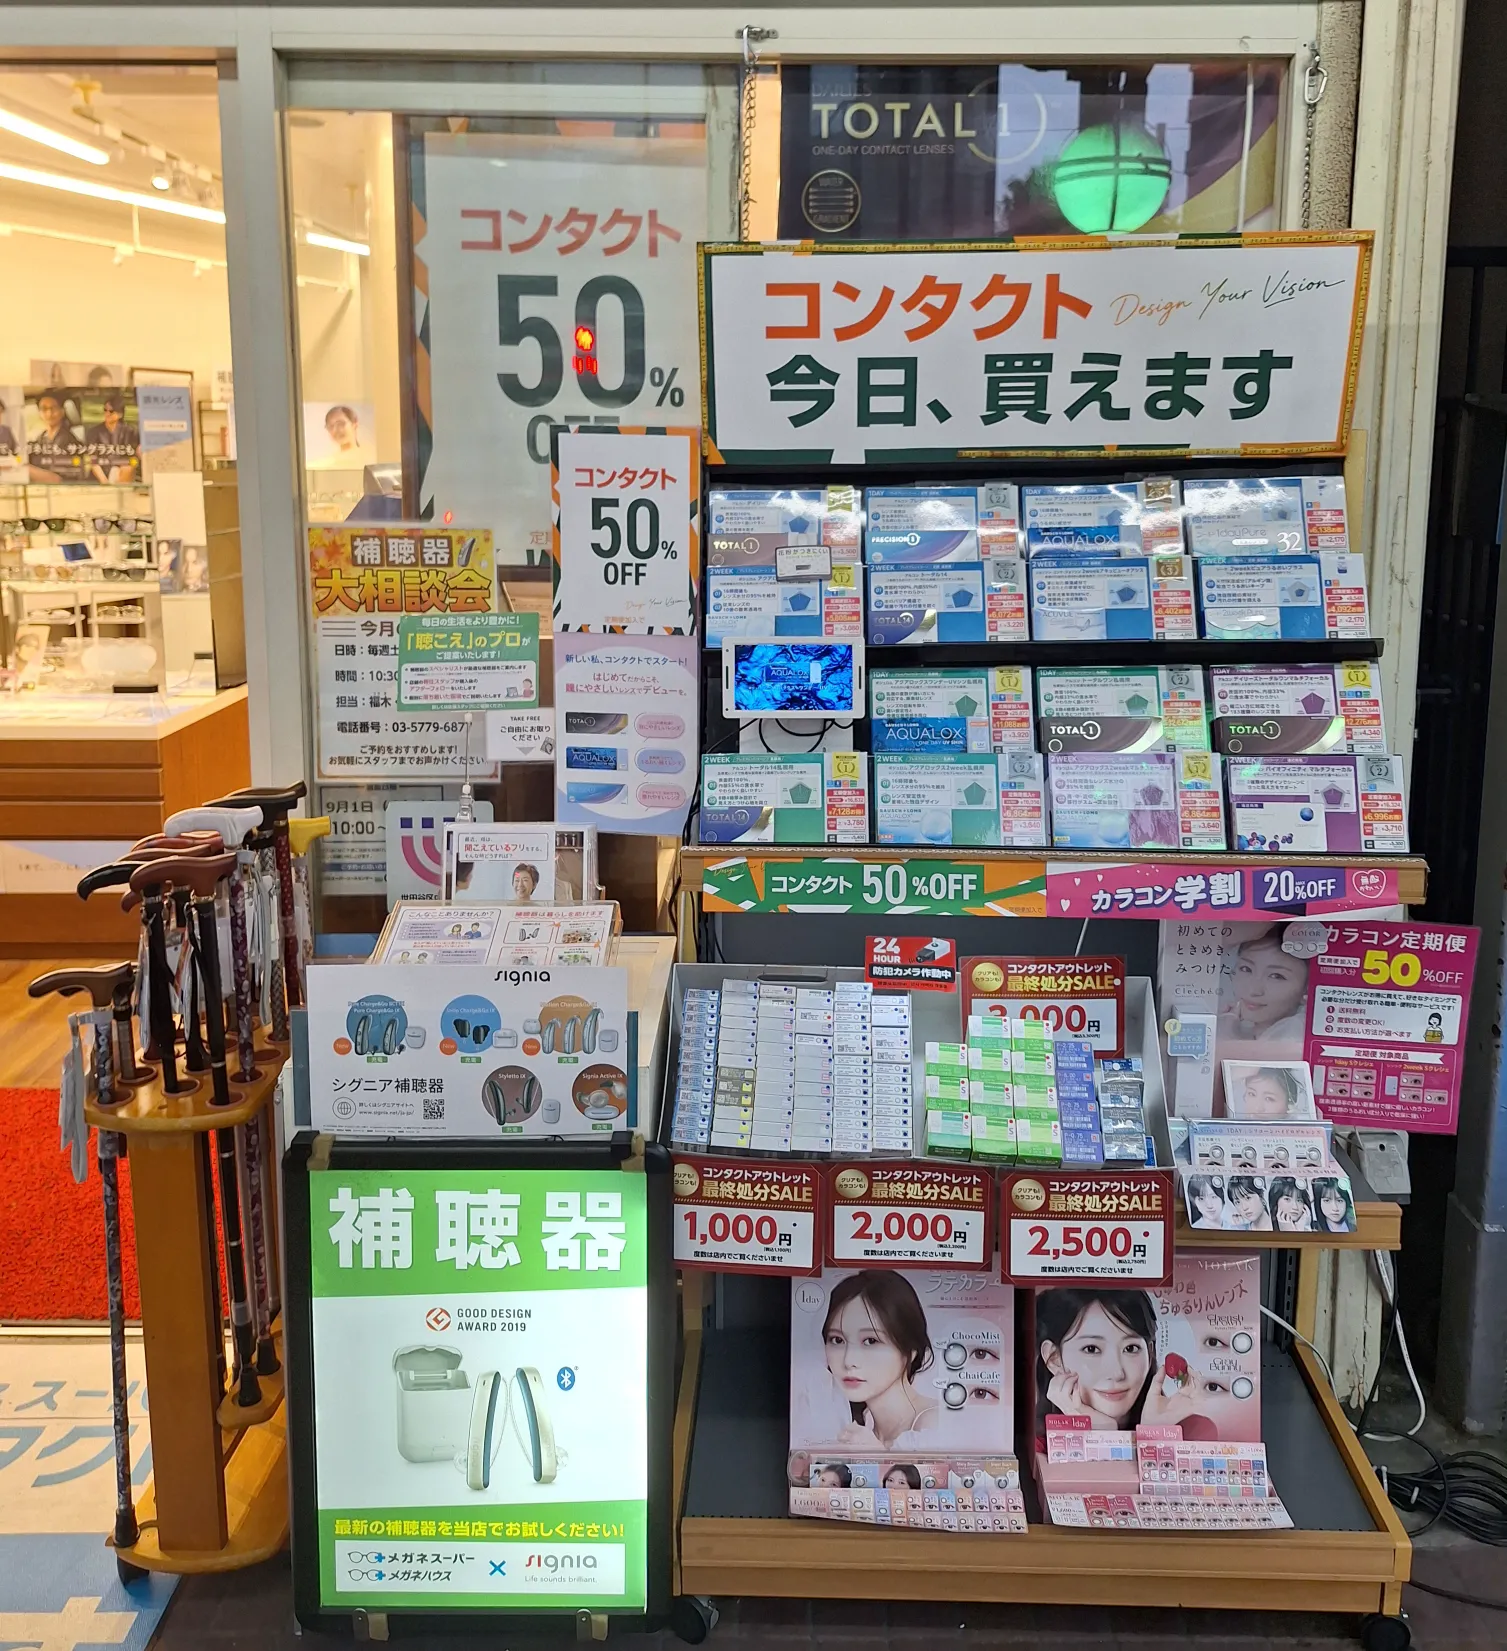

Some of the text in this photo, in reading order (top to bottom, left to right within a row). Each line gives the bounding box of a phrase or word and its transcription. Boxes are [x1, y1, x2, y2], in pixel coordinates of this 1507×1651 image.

[812, 102, 977, 139] TOTAL
[861, 144, 953, 155] CONTACT LENSES
[461, 207, 682, 258] コンタクト
[765, 270, 1345, 341] コンタクト Design Your Vision
[497, 274, 685, 410] 50%
[765, 349, 1288, 428] 今日、買えます
[574, 466, 677, 490] コンタクト
[590, 497, 677, 560] 50%
[1043, 535, 1115, 545] AQUALOX
[1277, 532, 1302, 552] 32
[354, 536, 452, 566] 補聴器
[603, 562, 647, 586] OFF
[315, 569, 492, 613] 大相談会
[407, 632, 531, 651] 「聴こえ」のプロが
[565, 654, 688, 667] 新しい私、コンタクトでスタート!
[592, 672, 661, 684] はじめてだからこそ、
[500, 725, 551, 734] ご自由にお取り
[886, 728, 962, 740] AQUALOX
[1050, 726, 1086, 734] TOTAL
[1229, 726, 1264, 734] TOTAL
[511, 733, 541, 742] ください
[360, 745, 458, 756] ご予約をおすすめします!
[326, 801, 373, 813] 9月1日
[706, 813, 736, 821] TOTAL
[771, 873, 853, 894] コンタクト
[1091, 870, 1241, 912] カラコン学割
[408, 910, 495, 918] こんなことありませんか?
[1178, 925, 1232, 937] 初めての
[1327, 925, 1468, 953] カラコン定期便
[873, 938, 900, 954] 24
[1176, 944, 1231, 956] ときめき、
[873, 954, 900, 963] HOUR
[1320, 958, 1358, 966] 定期便加入で
[873, 965, 952, 980] 防犯カメラ作動中
[1007, 963, 1112, 974] コンタクトアウトレット
[1176, 963, 1236, 976] みつけた。
[494, 969, 551, 986] signia
[1007, 975, 1115, 992] 最終処分SALE
[1338, 1007, 1366, 1015] 送料無料
[1337, 1016, 1385, 1026] 度数の変更OK!
[1337, 1026, 1412, 1038] お支払い方法が選べます
[1355, 1049, 1409, 1060] 定期便 対象商品
[332, 1077, 444, 1094] シグニア補聴器
[703, 1167, 811, 1184] コンタクトアウトレット
[872, 1171, 981, 1184] コンタクトアウトレット
[702, 1181, 812, 1202] 最終処分SALE
[872, 1181, 983, 1202] 最終処分SALE
[1049, 1181, 1160, 1192] コンタクトアウトレット
[1049, 1195, 1162, 1213] 最終処分SALE
[328, 1187, 627, 1272] 補聴器
[684, 1211, 792, 1247] 1,000円
[850, 1211, 967, 1244] 2,000円
[1027, 1226, 1146, 1260] 2,500円
[693, 1250, 783, 1263] 度数は店内でご覧くださいませ
[863, 1249, 954, 1258] 度数は店内でご覧くださいませ
[1040, 1266, 1133, 1274] 度数は店内でご覧くださいませ
[1197, 1259, 1254, 1272] MOLAK
[801, 1289, 821, 1305] 1day
[1160, 1279, 1249, 1316] ちゅるりんレンズ
[457, 1308, 532, 1319] GOOD DESIGN
[457, 1321, 526, 1332] AWARD 2019
[951, 1331, 1000, 1341] ChocoMist
[1071, 1417, 1087, 1428] 1day
[1163, 1429, 1179, 1439] 1day
[334, 1518, 625, 1537] 最新の補聴器を当店でお試しください!
[387, 1551, 475, 1564] メガネスーパー
[525, 1553, 598, 1572] signia
[387, 1569, 452, 1582] メガネハウス
[524, 1574, 597, 1583] Life sounds brilliant.
